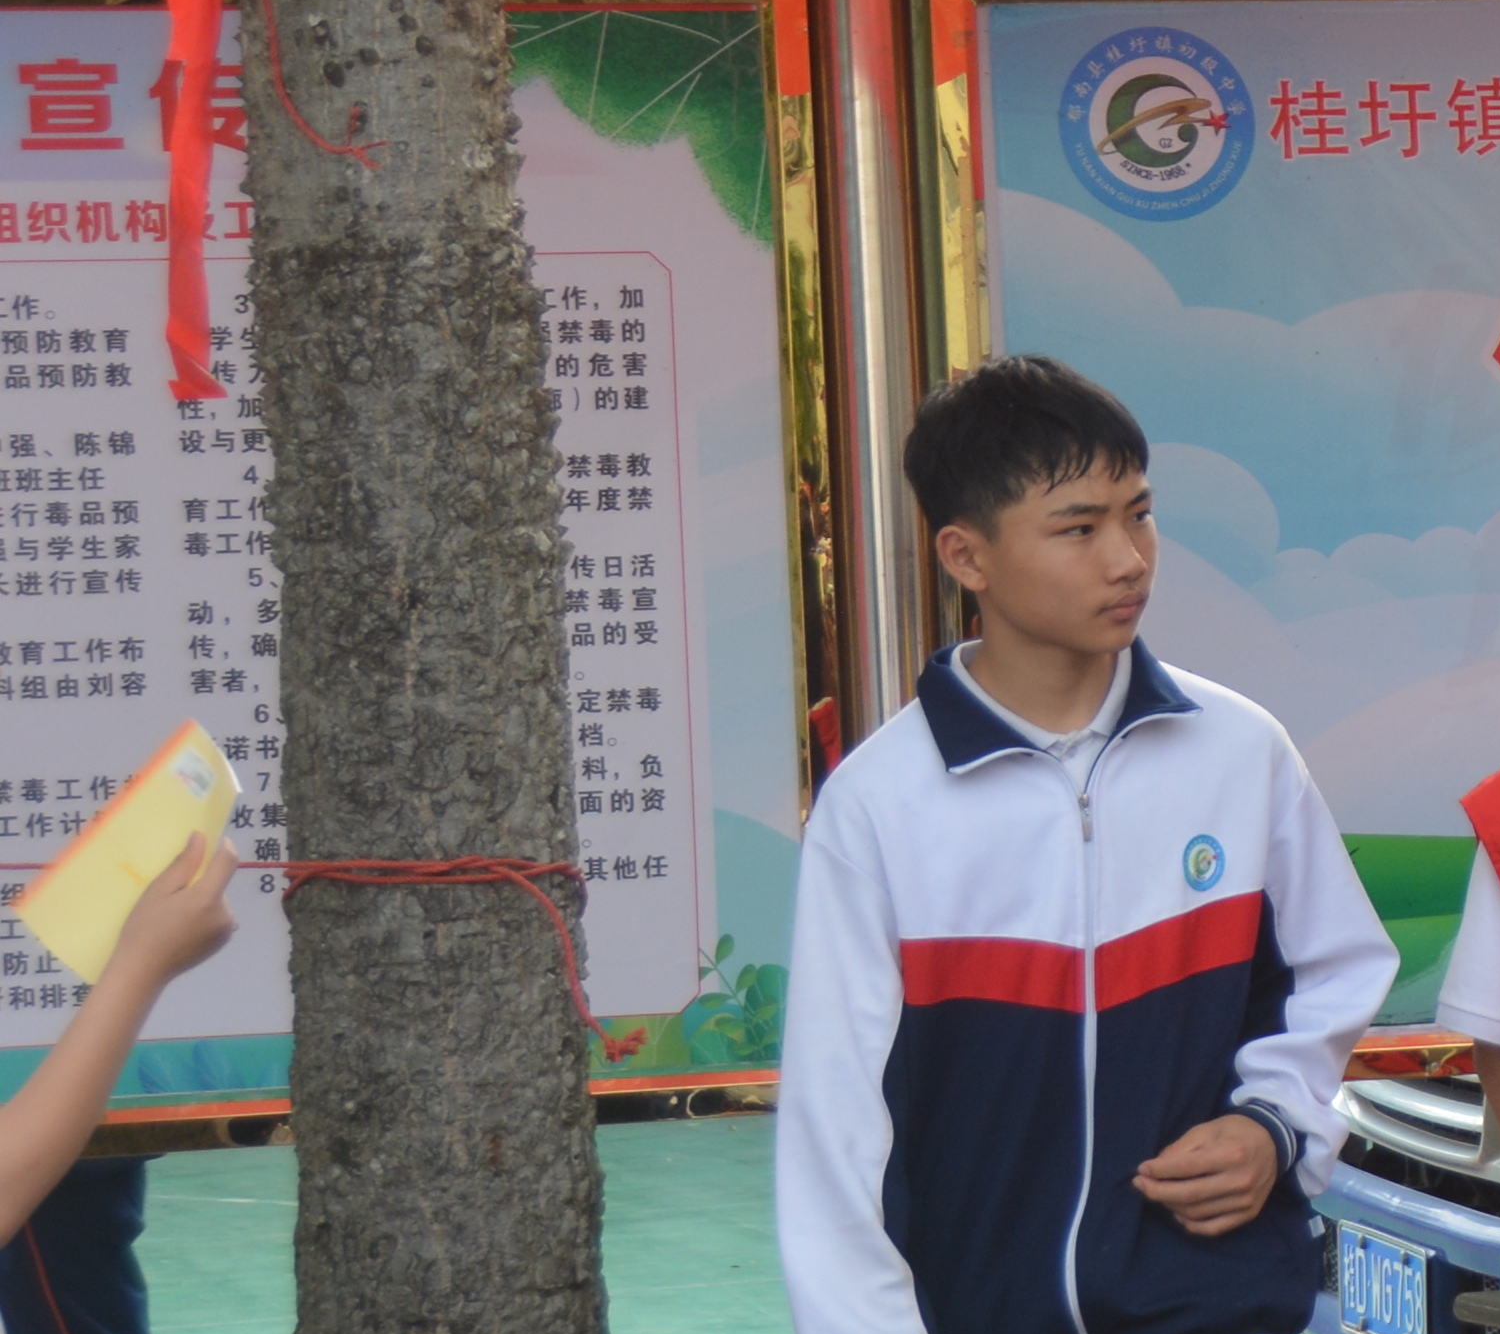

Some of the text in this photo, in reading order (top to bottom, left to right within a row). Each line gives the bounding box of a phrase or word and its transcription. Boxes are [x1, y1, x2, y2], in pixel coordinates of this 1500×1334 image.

[2, 328, 130, 354] 预防教育
[5, 363, 132, 390] 品预防教
[555, 351, 648, 378] 的危害
[0, 431, 136, 458] 强、陈锦
[566, 452, 652, 479] 禁毒教
[565, 485, 654, 512] 年度禁
[0, 500, 140, 528] 行毒品预
[0, 534, 141, 562] 与学生家
[570, 553, 656, 579] 传日活
[571, 620, 660, 647] 品的受
[223, 735, 280, 762] 诺书
[0, 775, 138, 805] 毒工作
[579, 787, 667, 815] 面的资
[0, 981, 94, 1010] 和排查
